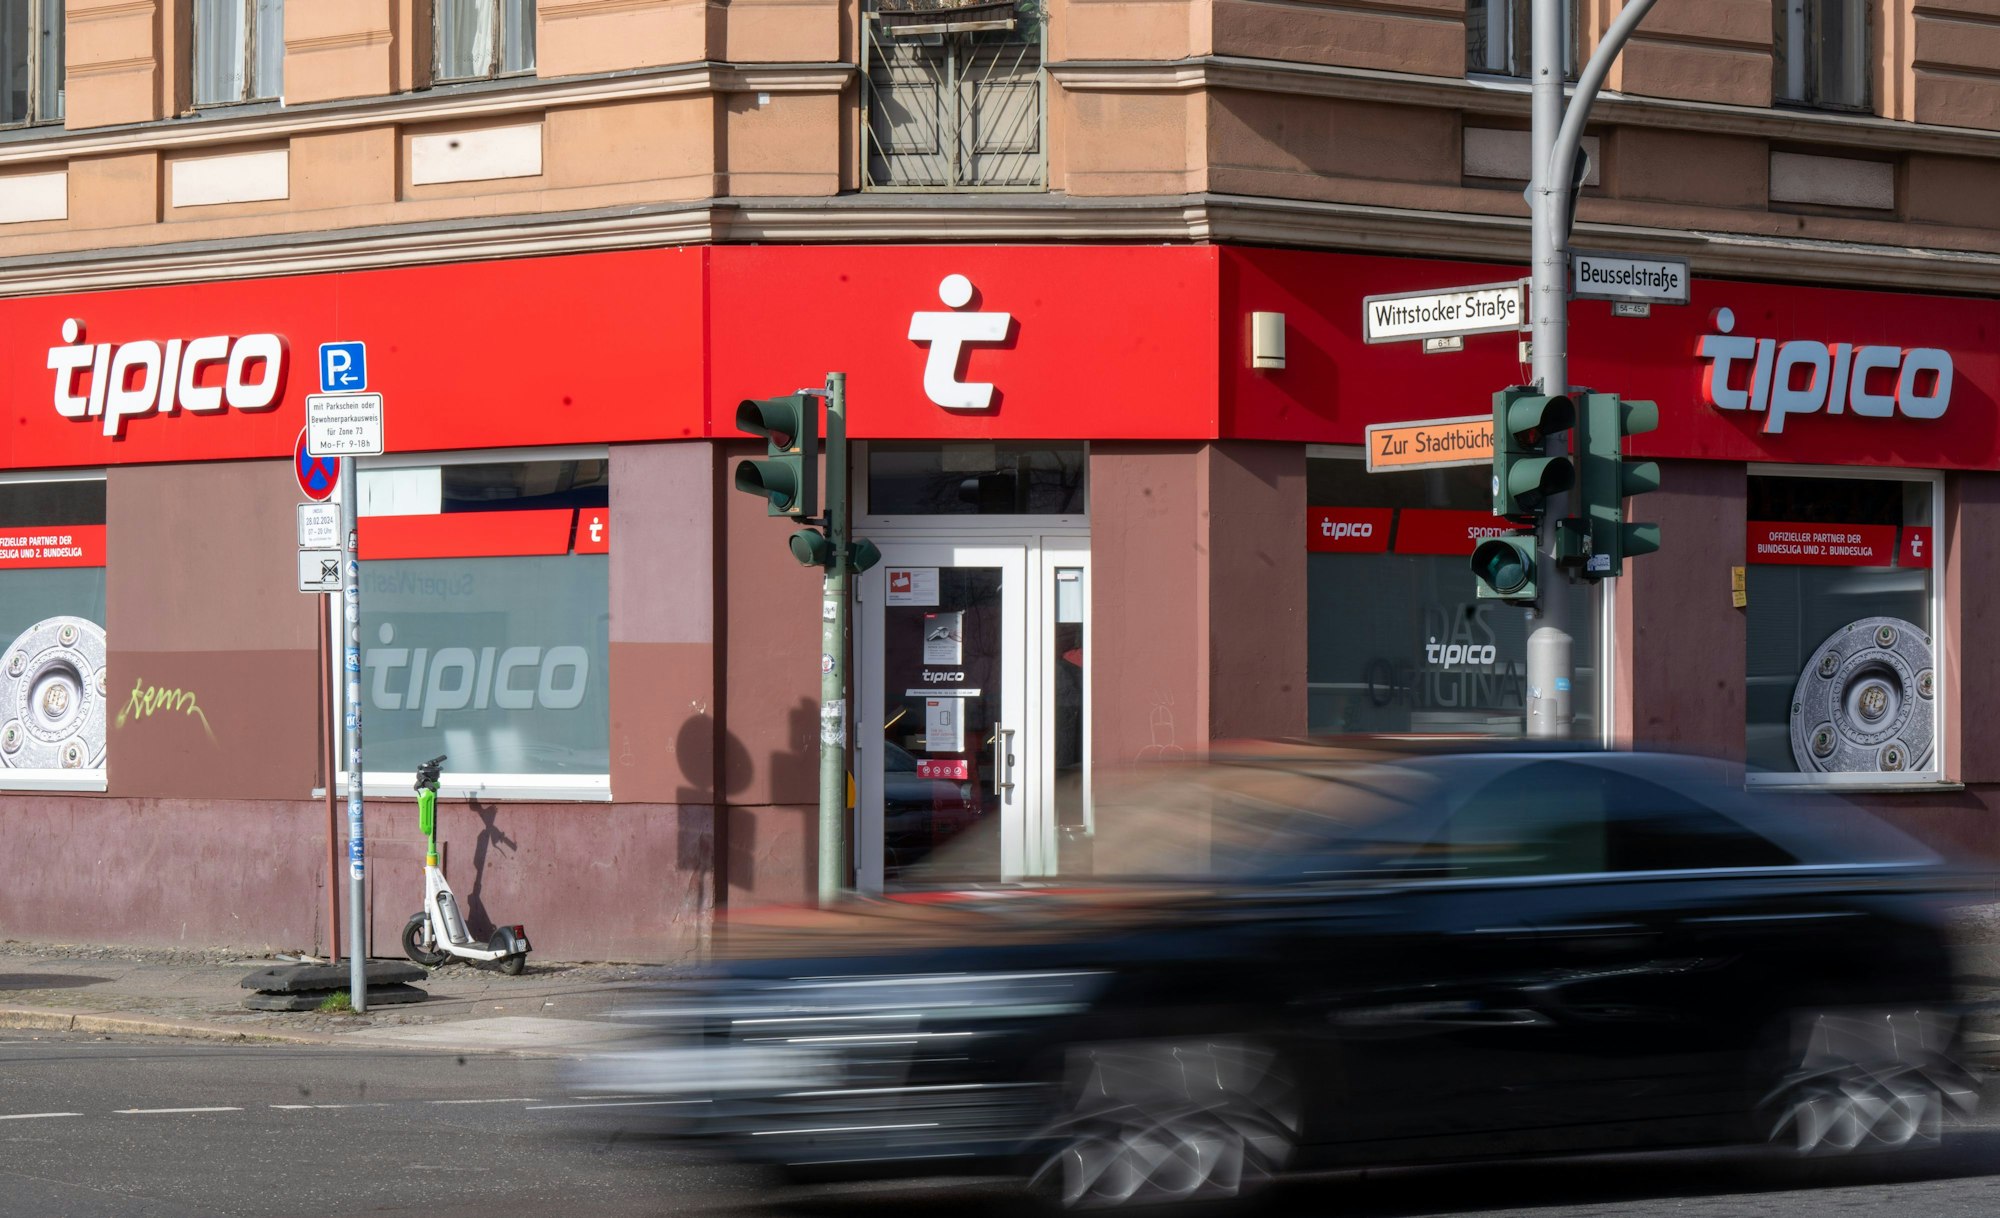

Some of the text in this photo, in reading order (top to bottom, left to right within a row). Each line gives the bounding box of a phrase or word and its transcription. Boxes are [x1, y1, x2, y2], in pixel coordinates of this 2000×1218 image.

[1581, 261, 1678, 292] Beusselstraße
[1375, 294, 1516, 327] Wittstocker Straße
[46, 317, 284, 437] tipico
[327, 349, 352, 386] P
[1701, 306, 1954, 434] tipico
[313, 401, 376, 411] mit Parkschein oder
[311, 414, 379, 425] Bewohnerparkausweis
[327, 427, 364, 436] für Zone 73
[349, 439, 371, 448] 9-18h
[1381, 434, 1409, 456] Zur
[1321, 516, 1373, 541] tipico
[1768, 531, 1862, 544] OFFIZIELLER PARTNER DER
[29, 535, 58, 546] PARTNER
[59, 535, 72, 545] DER
[1757, 543, 1873, 557] BUNDESLIGA UND 2. BUNDESLIGA
[20, 548, 34, 558] UND
[35, 548, 42, 558] 2.
[43, 547, 83, 557] BUNDESLIGA
[1425, 636, 1496, 669] tipico
[364, 622, 589, 728] tipico
[922, 668, 965, 684] tipico
